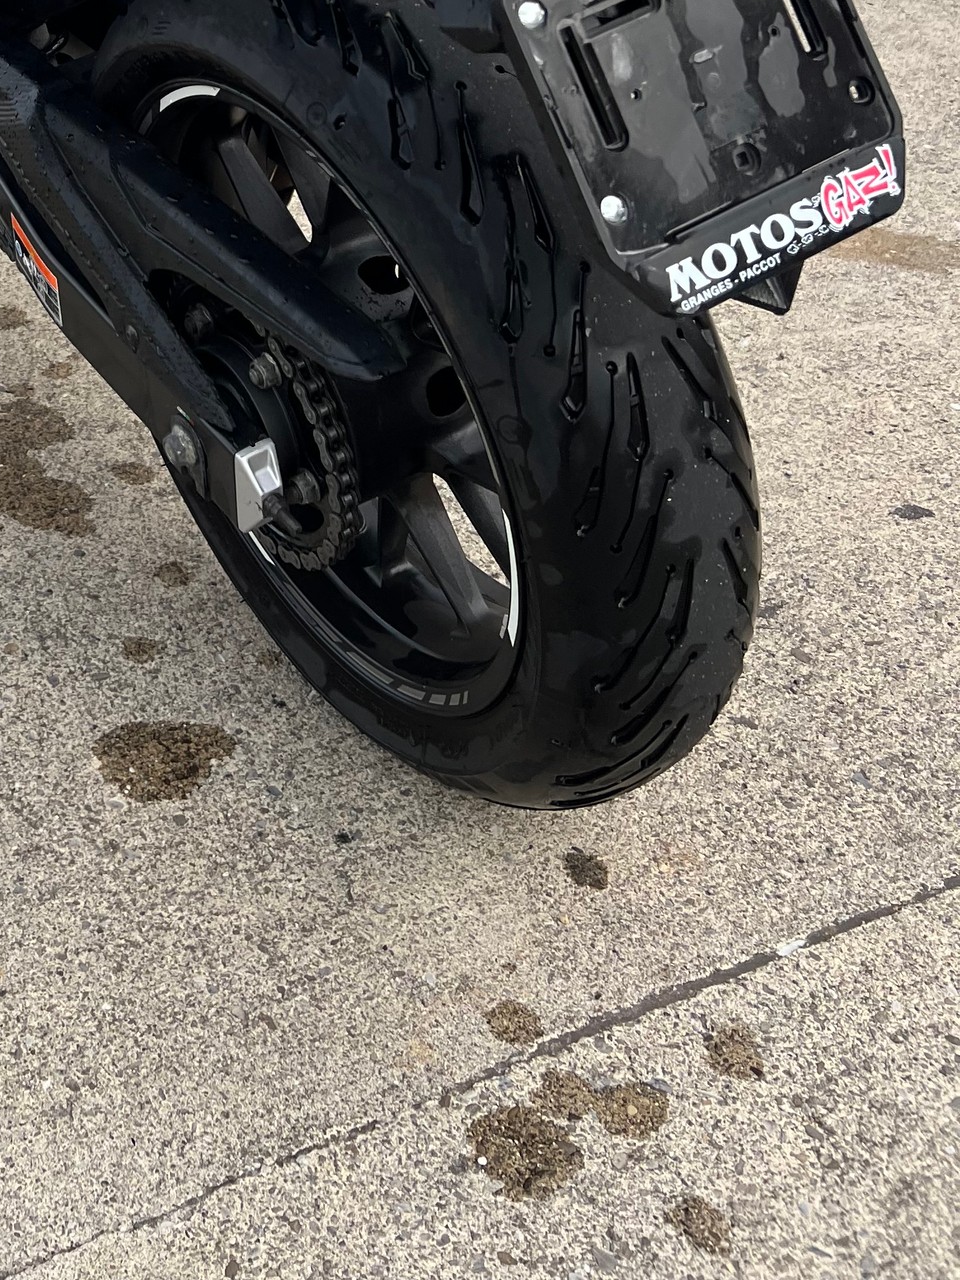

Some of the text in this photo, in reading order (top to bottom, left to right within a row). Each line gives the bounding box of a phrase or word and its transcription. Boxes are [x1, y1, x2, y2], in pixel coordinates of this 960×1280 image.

[665, 143, 901, 303] MOTOS GAZ!
[680, 277, 734, 312] GRANGES
[739, 252, 782, 283] PACCOT
